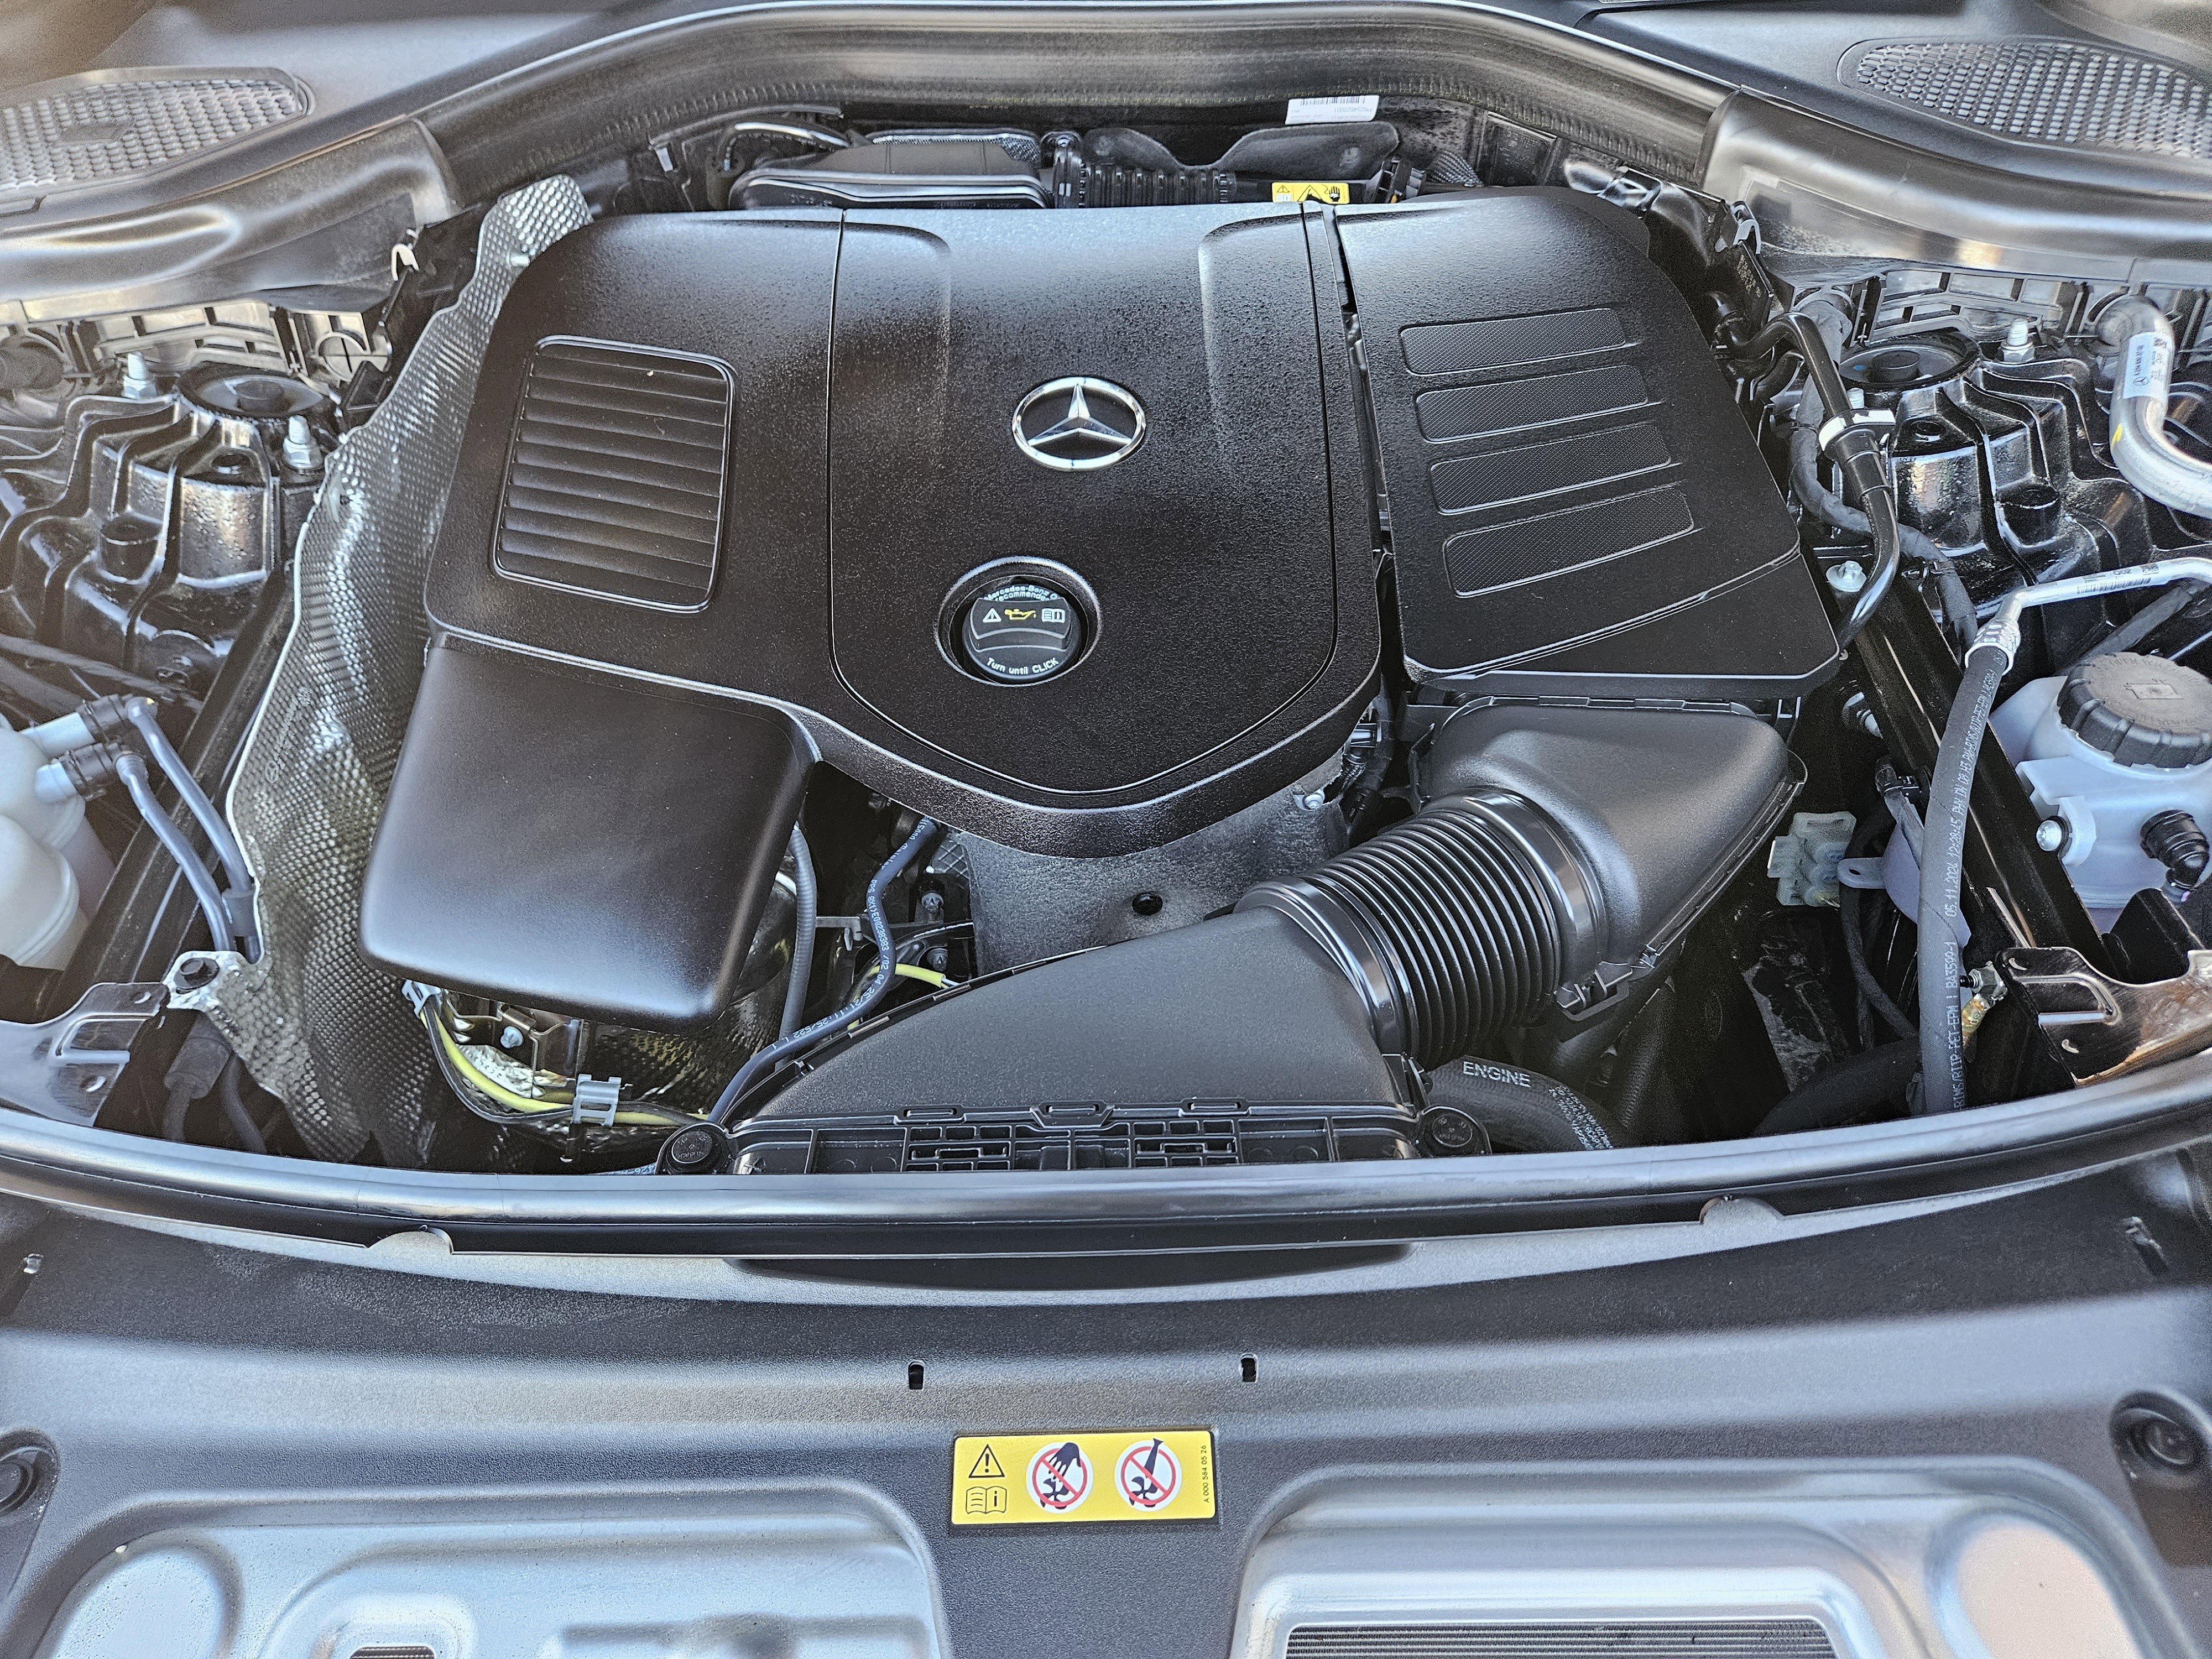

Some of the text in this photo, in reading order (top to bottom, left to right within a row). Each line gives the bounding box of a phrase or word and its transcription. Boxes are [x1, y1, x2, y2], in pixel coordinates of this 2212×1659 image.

[987, 657, 1059, 675] Turn until CLICK
[1463, 1061, 1531, 1088] ENGINE
[1200, 1445, 1207, 1454] 26
[1201, 1455, 1207, 1465] 05
